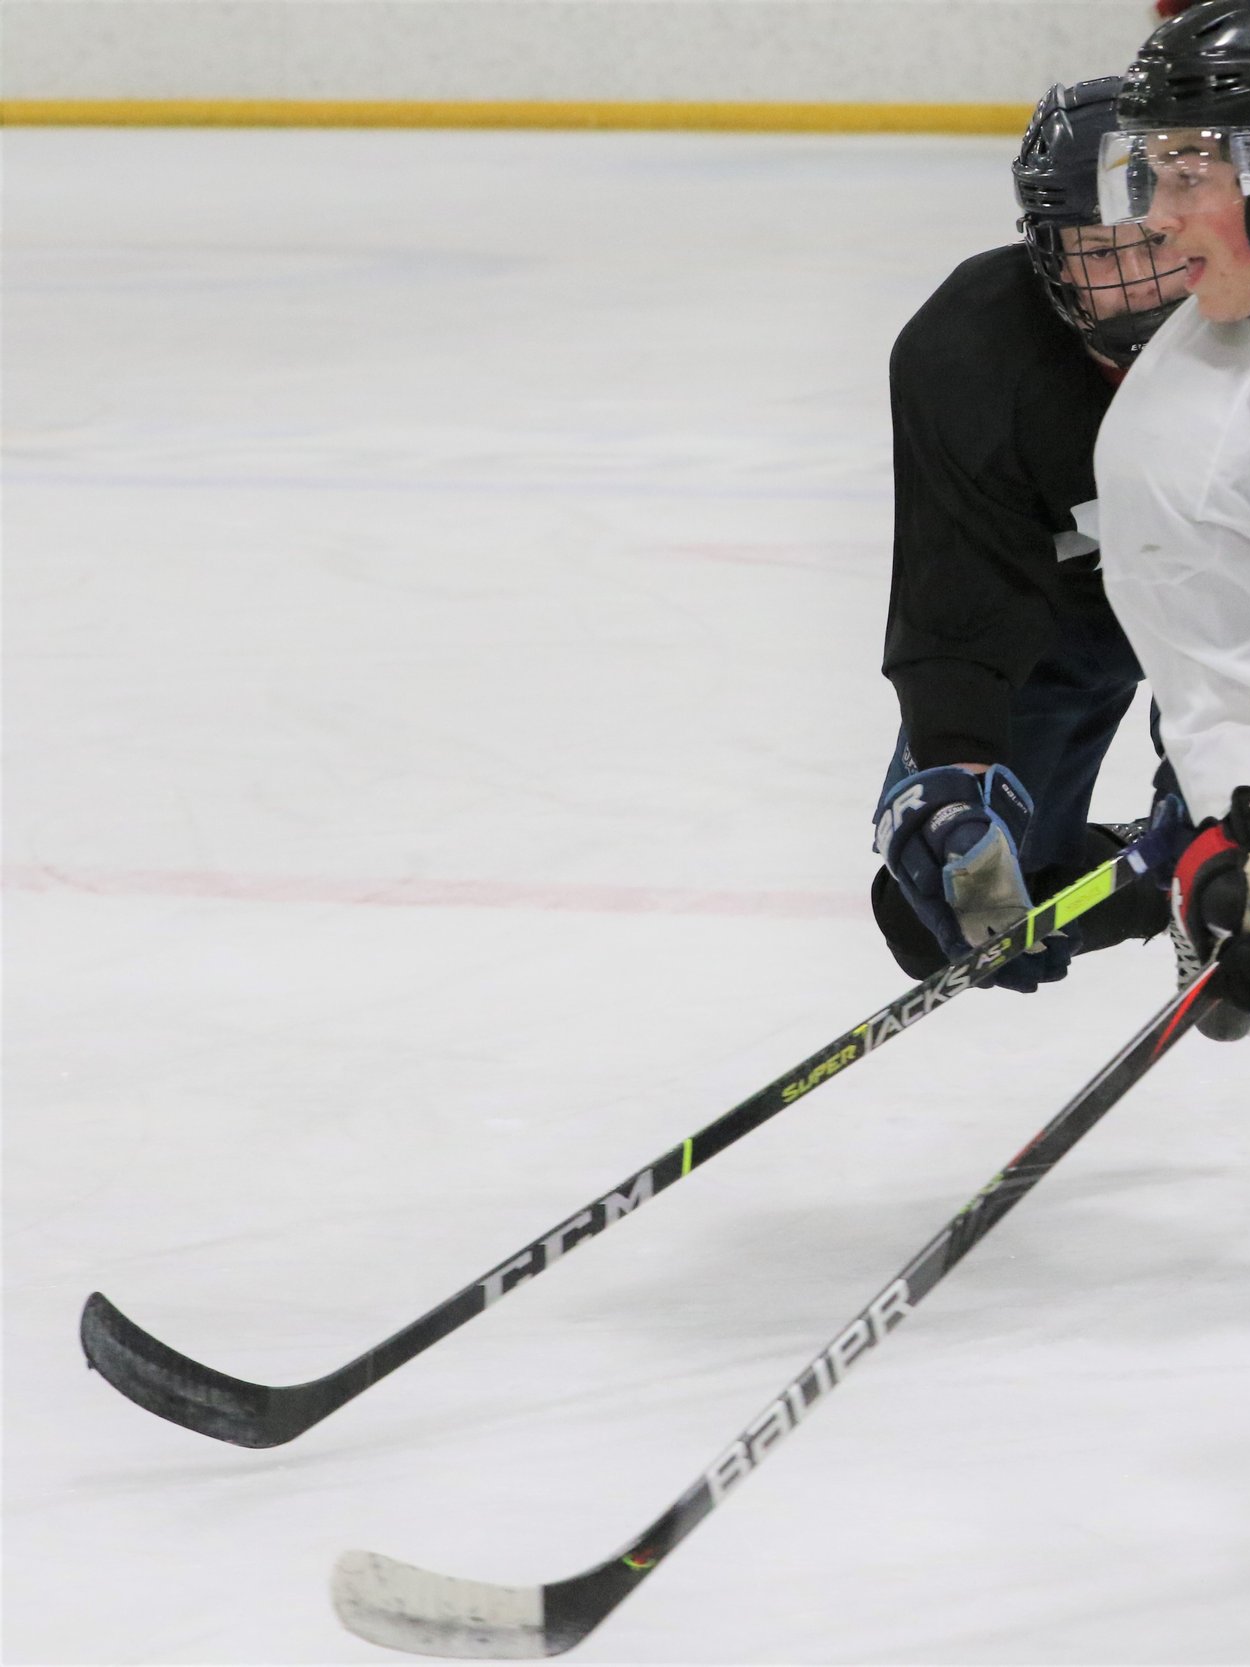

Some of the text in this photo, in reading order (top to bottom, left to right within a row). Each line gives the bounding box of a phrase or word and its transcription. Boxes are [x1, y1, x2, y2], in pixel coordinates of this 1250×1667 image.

[782, 1044, 857, 1103] SUPER
[862, 965, 971, 1055] TACKS
[478, 1168, 654, 1308] CCM
[705, 1278, 911, 1506] BAUER
